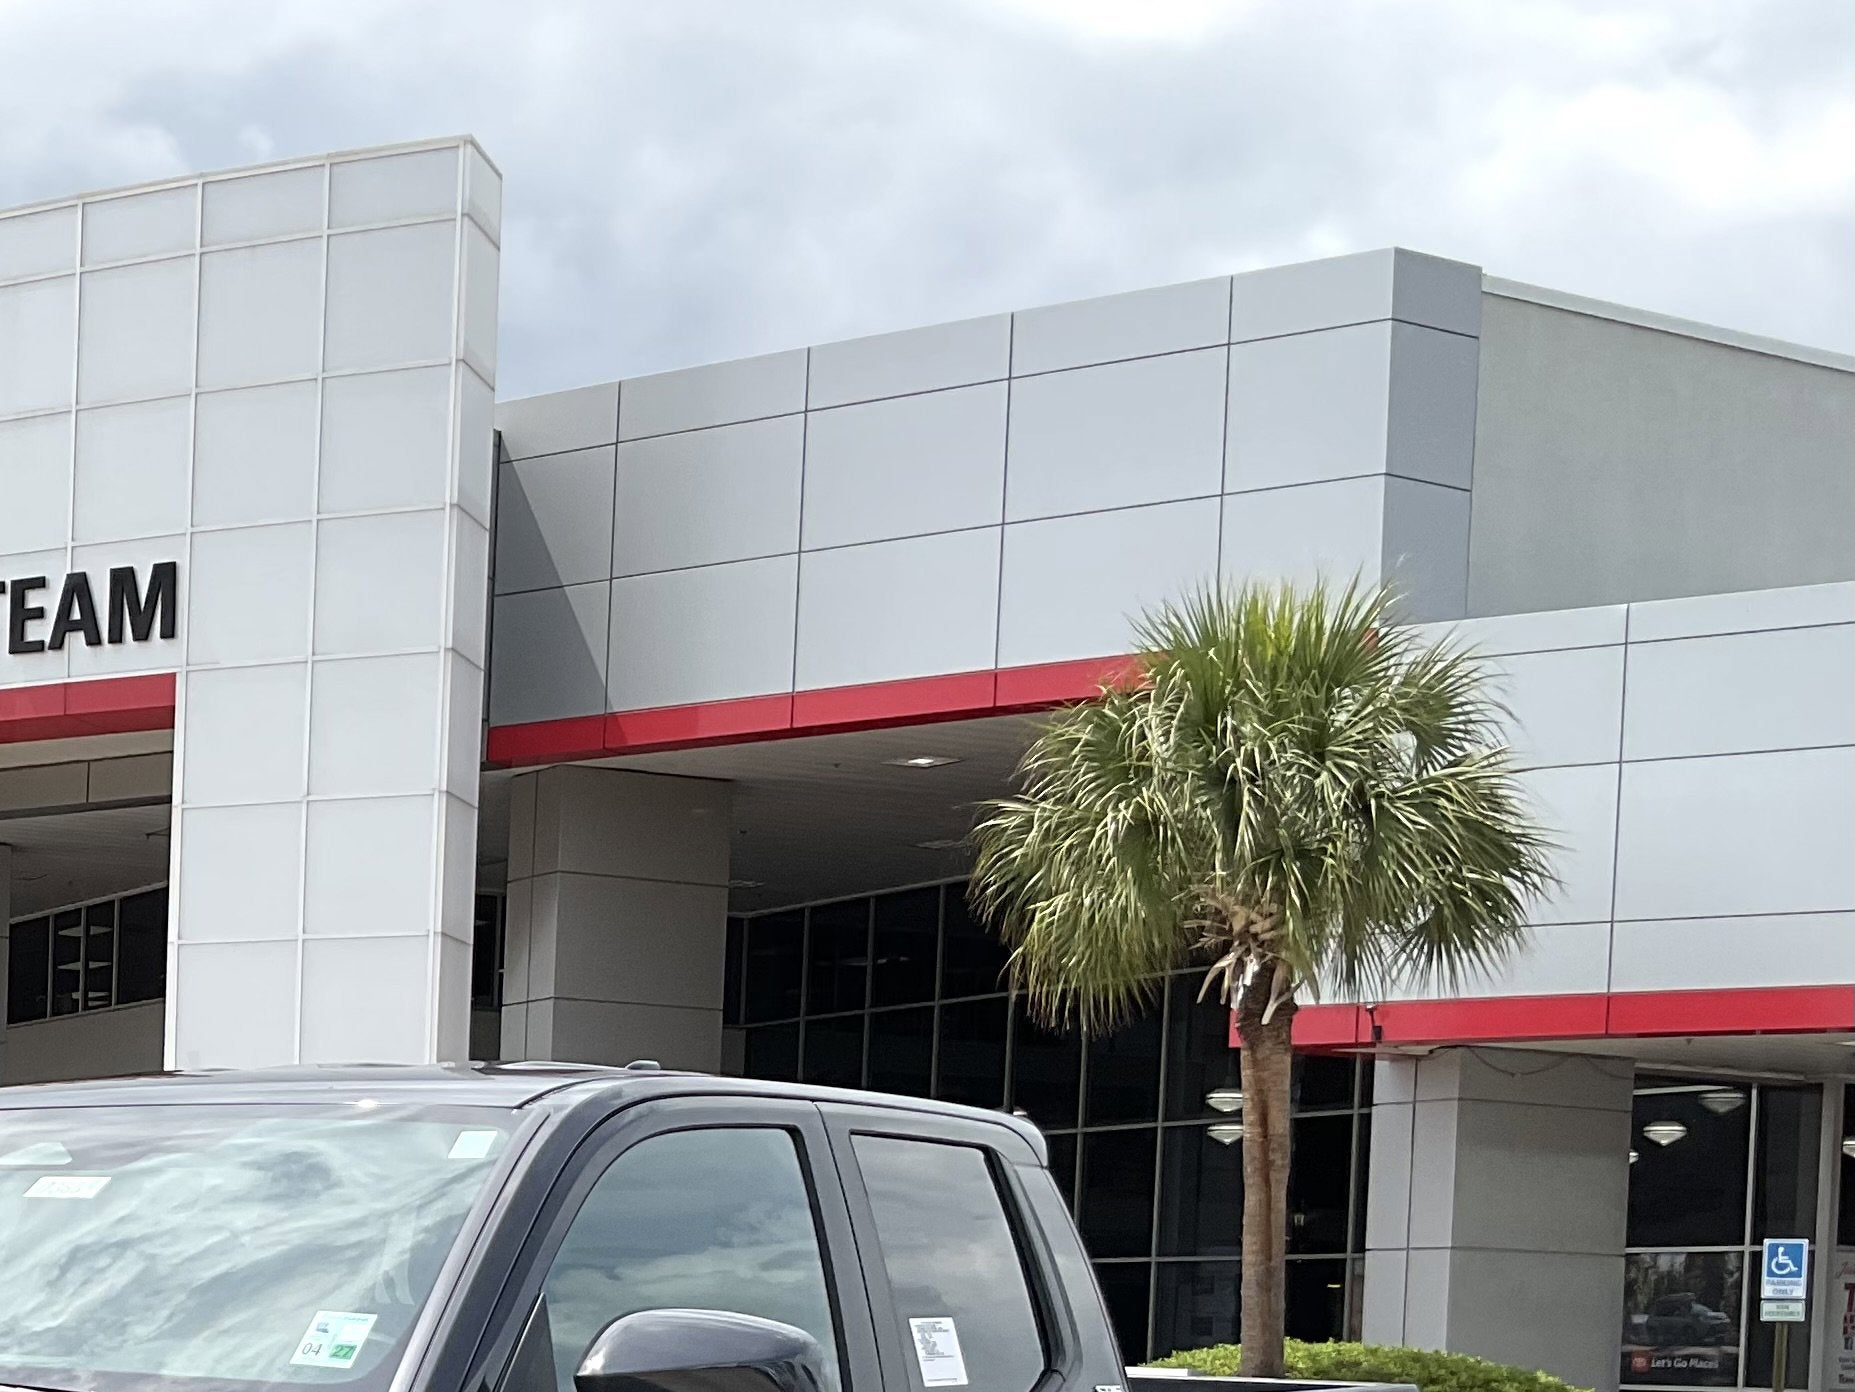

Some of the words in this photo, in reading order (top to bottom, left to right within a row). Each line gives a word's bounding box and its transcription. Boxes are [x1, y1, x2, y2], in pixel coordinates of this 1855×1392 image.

[302, 1342, 323, 1356] 04
[331, 1344, 357, 1359] 27
[1651, 1358, 1672, 1368] Let's
[1673, 1358, 1687, 1368] Go
[1688, 1358, 1719, 1369] Places
